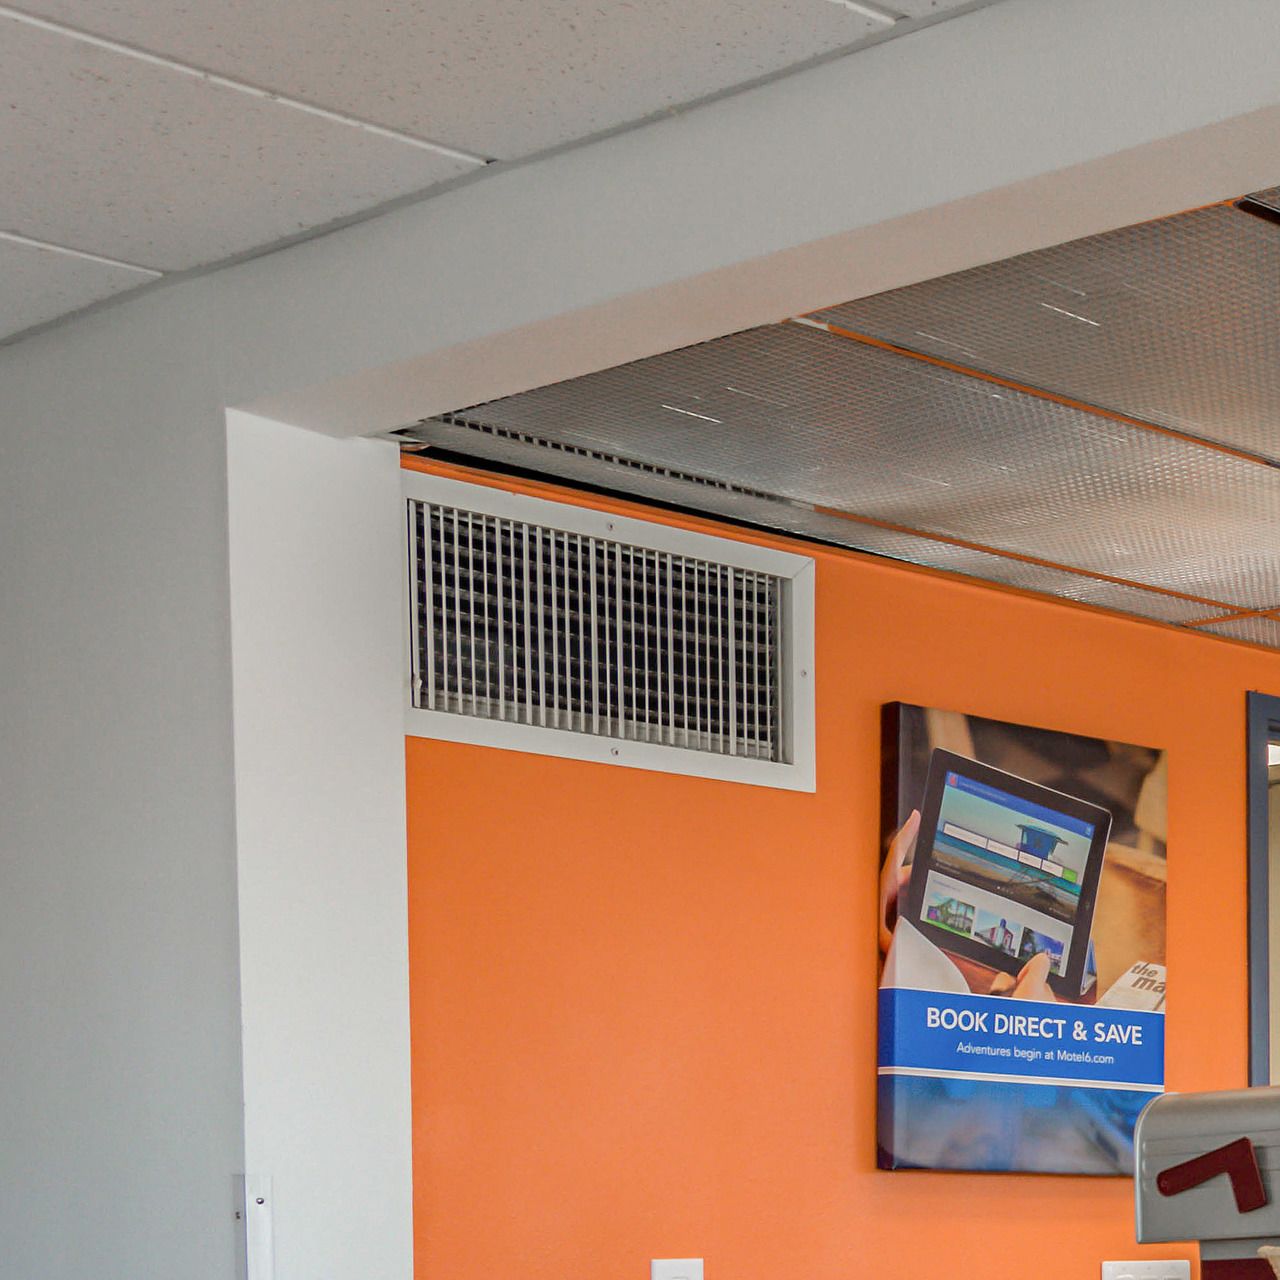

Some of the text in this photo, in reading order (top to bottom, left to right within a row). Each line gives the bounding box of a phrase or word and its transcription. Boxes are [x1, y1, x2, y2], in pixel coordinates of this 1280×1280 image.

[1131, 962, 1158, 978] the
[926, 1007, 1143, 1045] BOOK DIRECT & SAVE
[956, 1041, 1114, 1064] Adventures begin at Motel6.com
